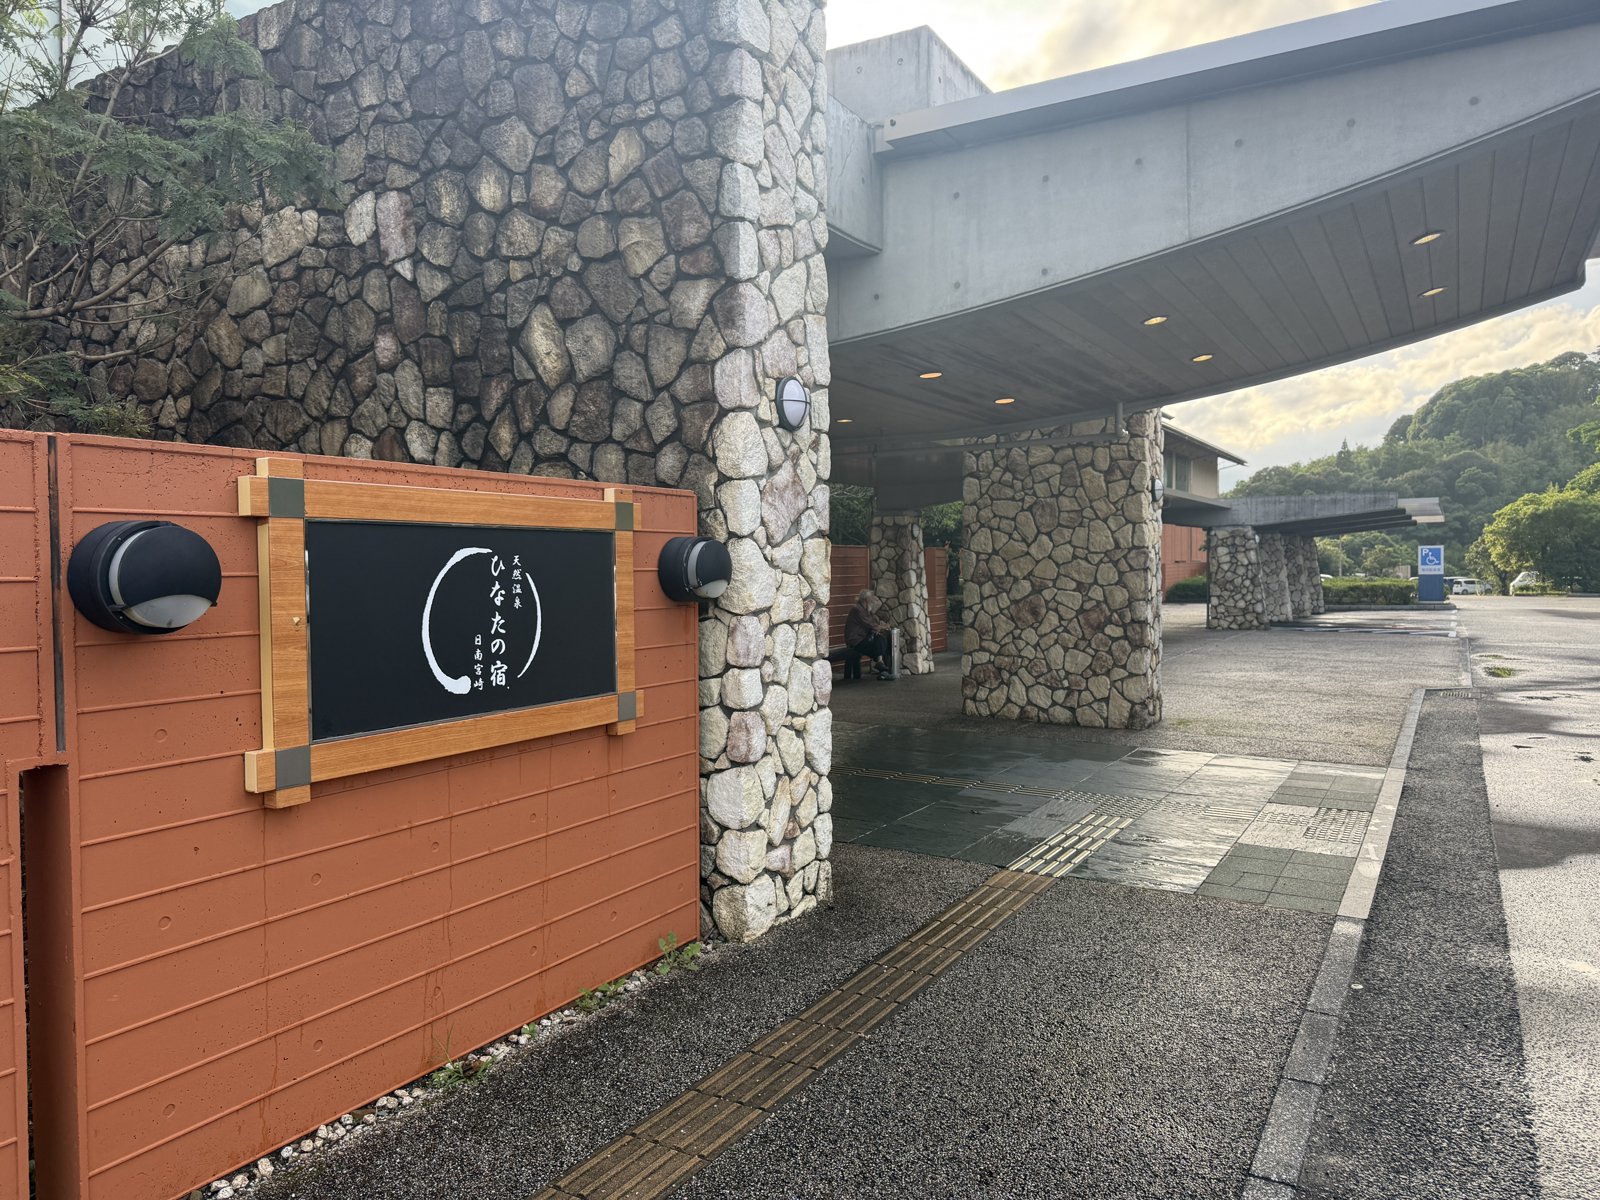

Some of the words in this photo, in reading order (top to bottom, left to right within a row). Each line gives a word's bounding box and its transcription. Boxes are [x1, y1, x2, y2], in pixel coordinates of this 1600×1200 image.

[1422, 548, 1429, 557] P
[511, 554, 523, 610] 天然温泉
[473, 633, 484, 691] 日南宮崎
